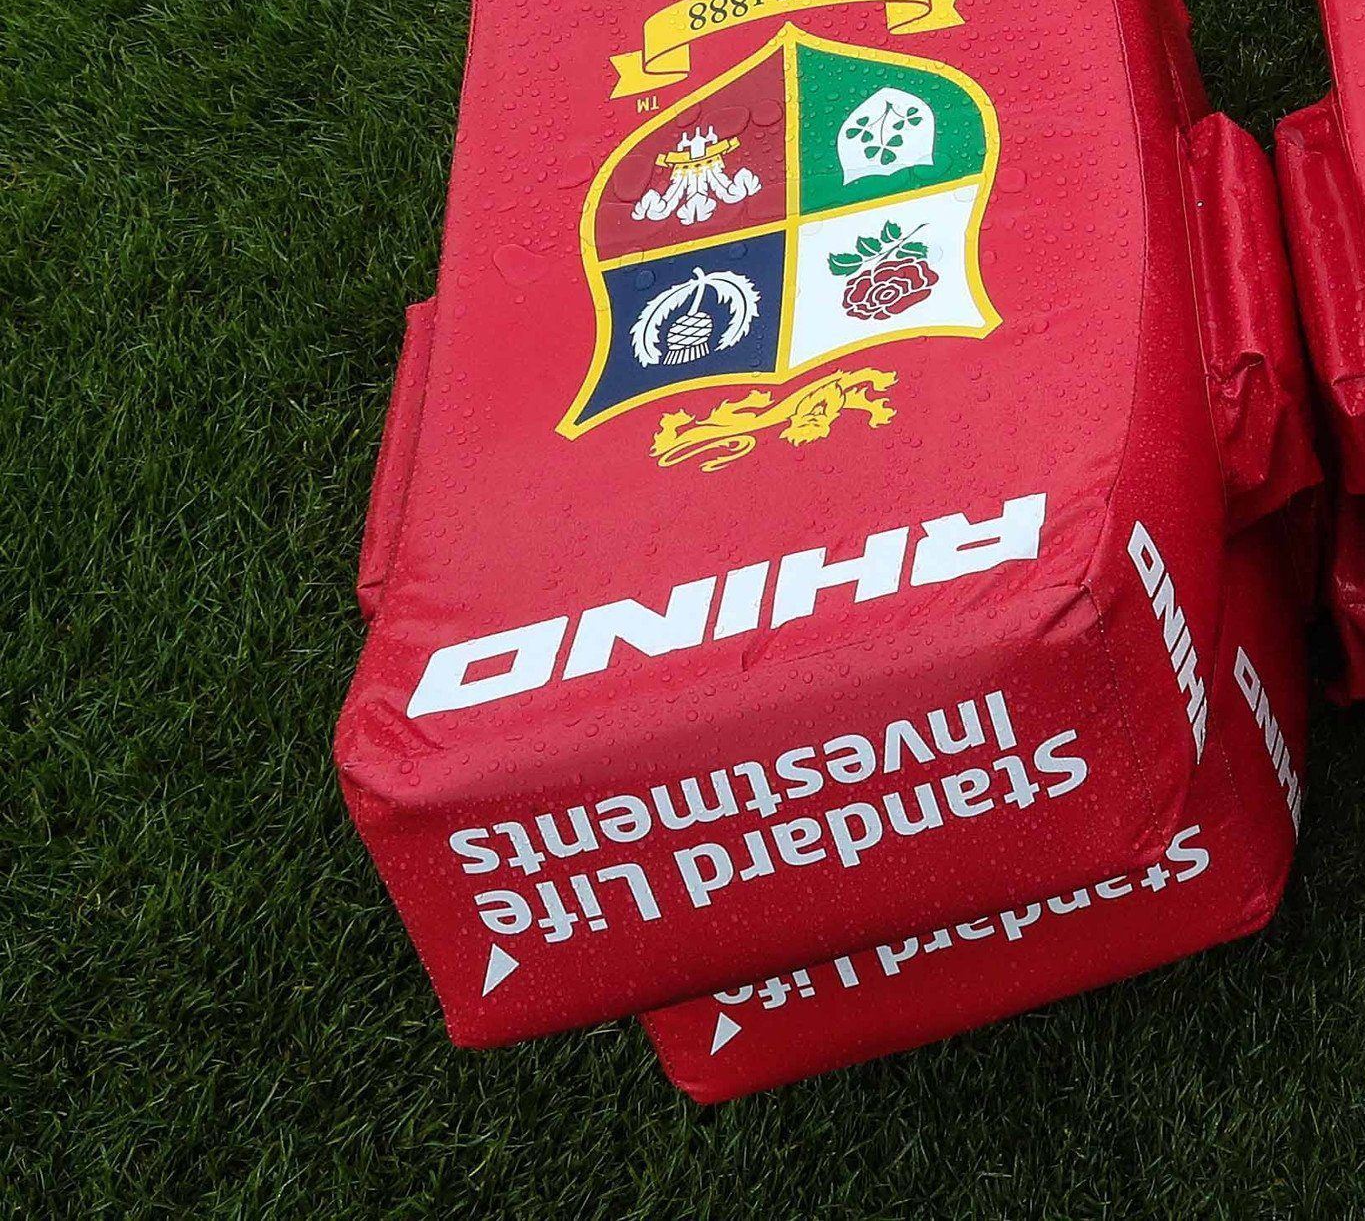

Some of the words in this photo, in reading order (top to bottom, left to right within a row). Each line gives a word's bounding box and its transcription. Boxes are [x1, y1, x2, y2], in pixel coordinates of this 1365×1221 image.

[635, 95, 661, 114] TM
[405, 492, 1048, 720] RHINO
[448, 690, 1017, 876] Investments
[673, 729, 1090, 909] Standard
[476, 861, 664, 946] Life
